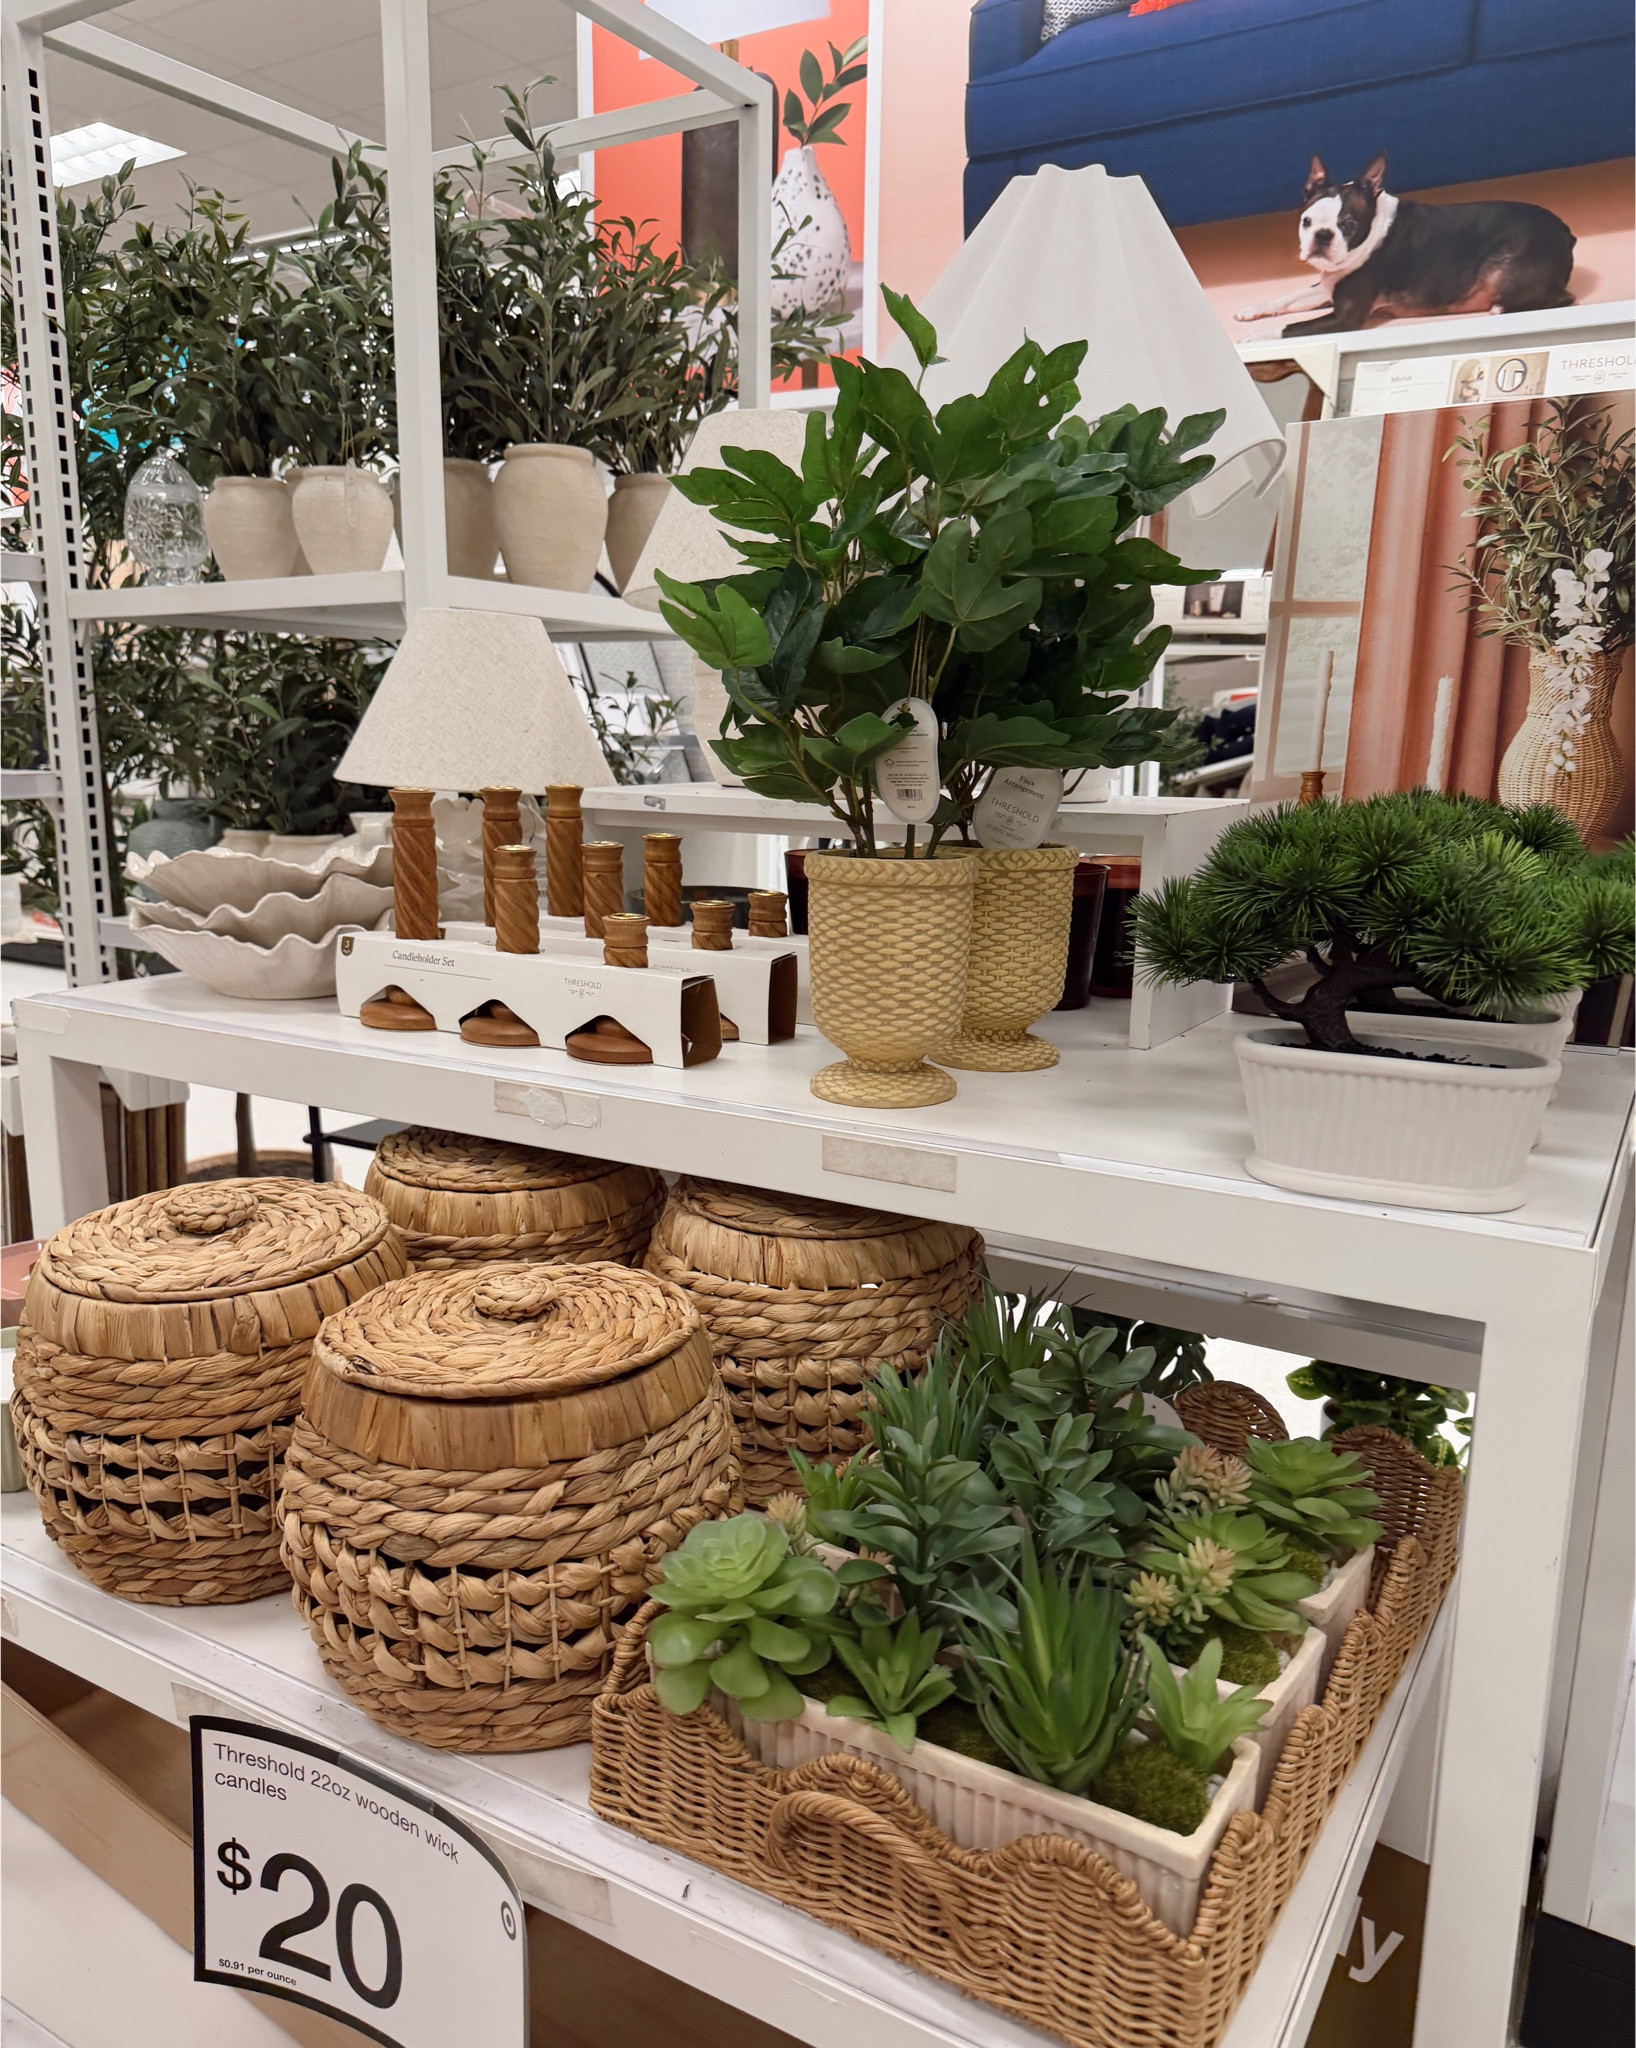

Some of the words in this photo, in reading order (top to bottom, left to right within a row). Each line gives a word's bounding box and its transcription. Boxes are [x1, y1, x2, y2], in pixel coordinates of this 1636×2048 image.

[1561, 355, 1635, 370] THRESHOL
[1003, 778, 1045, 800] Arrangement
[1020, 775, 1035, 787] Faux
[991, 797, 1040, 823] THRESHOLD
[392, 950, 441, 965] Candleholder
[441, 956, 455, 967] Set
[564, 977, 602, 990] THRESHOLD
[214, 1772, 287, 1801] candles
[213, 1742, 305, 1782] Threshold
[310, 1769, 352, 1802] 22oz
[355, 1792, 419, 1838] wooden
[424, 1829, 459, 1865] wick
[218, 1958, 245, 1971] $0.91
[247, 1966, 264, 1976] per
[266, 1971, 297, 1986] ounce
